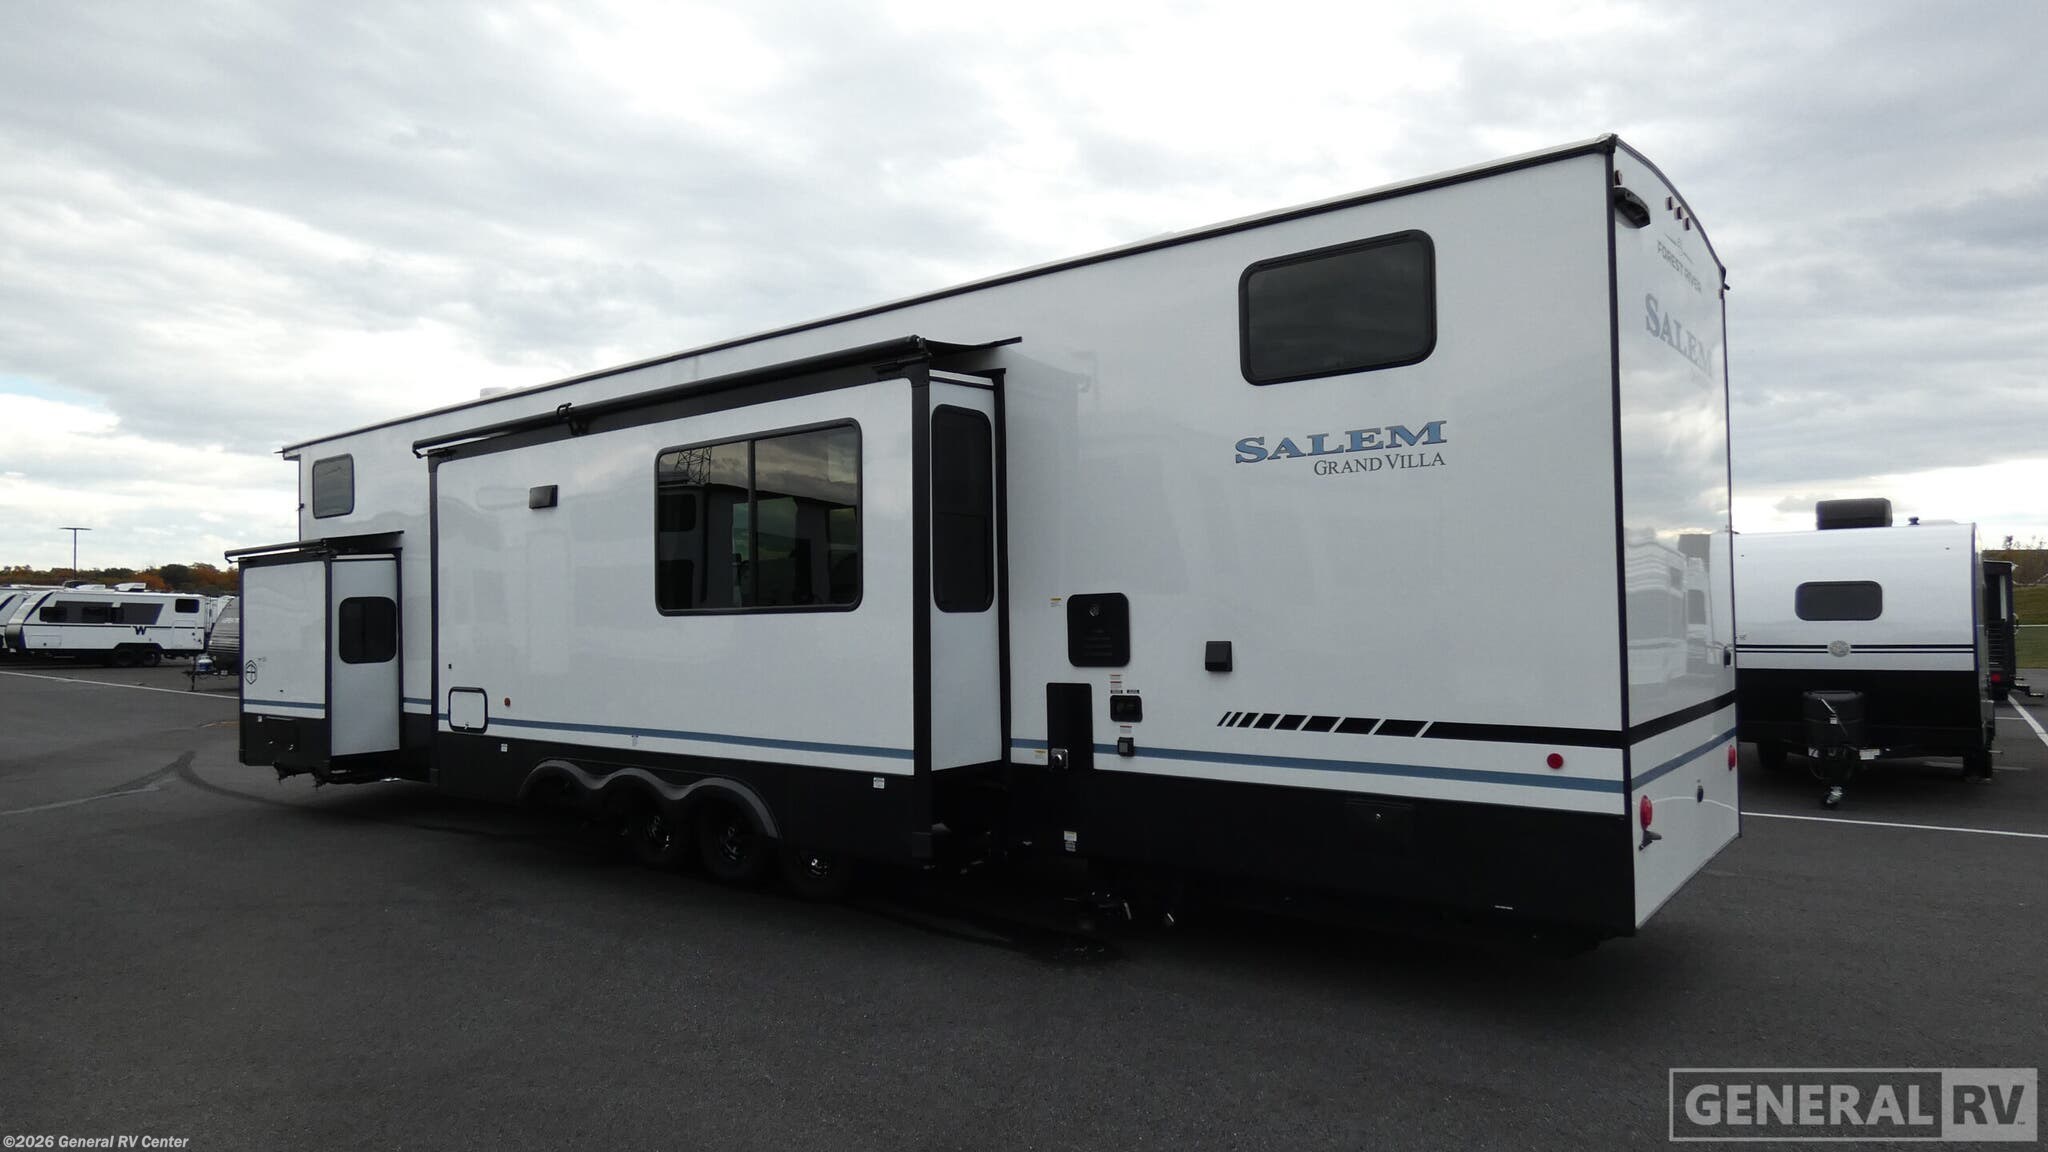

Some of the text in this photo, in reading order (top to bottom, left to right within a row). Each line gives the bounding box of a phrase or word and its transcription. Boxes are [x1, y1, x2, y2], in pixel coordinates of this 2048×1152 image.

[1657, 241, 1683, 276] FOREST
[1645, 293, 1711, 377] SALEM
[1235, 420, 1448, 464] SALEM
[1313, 451, 1446, 477] GRAND VILLA
